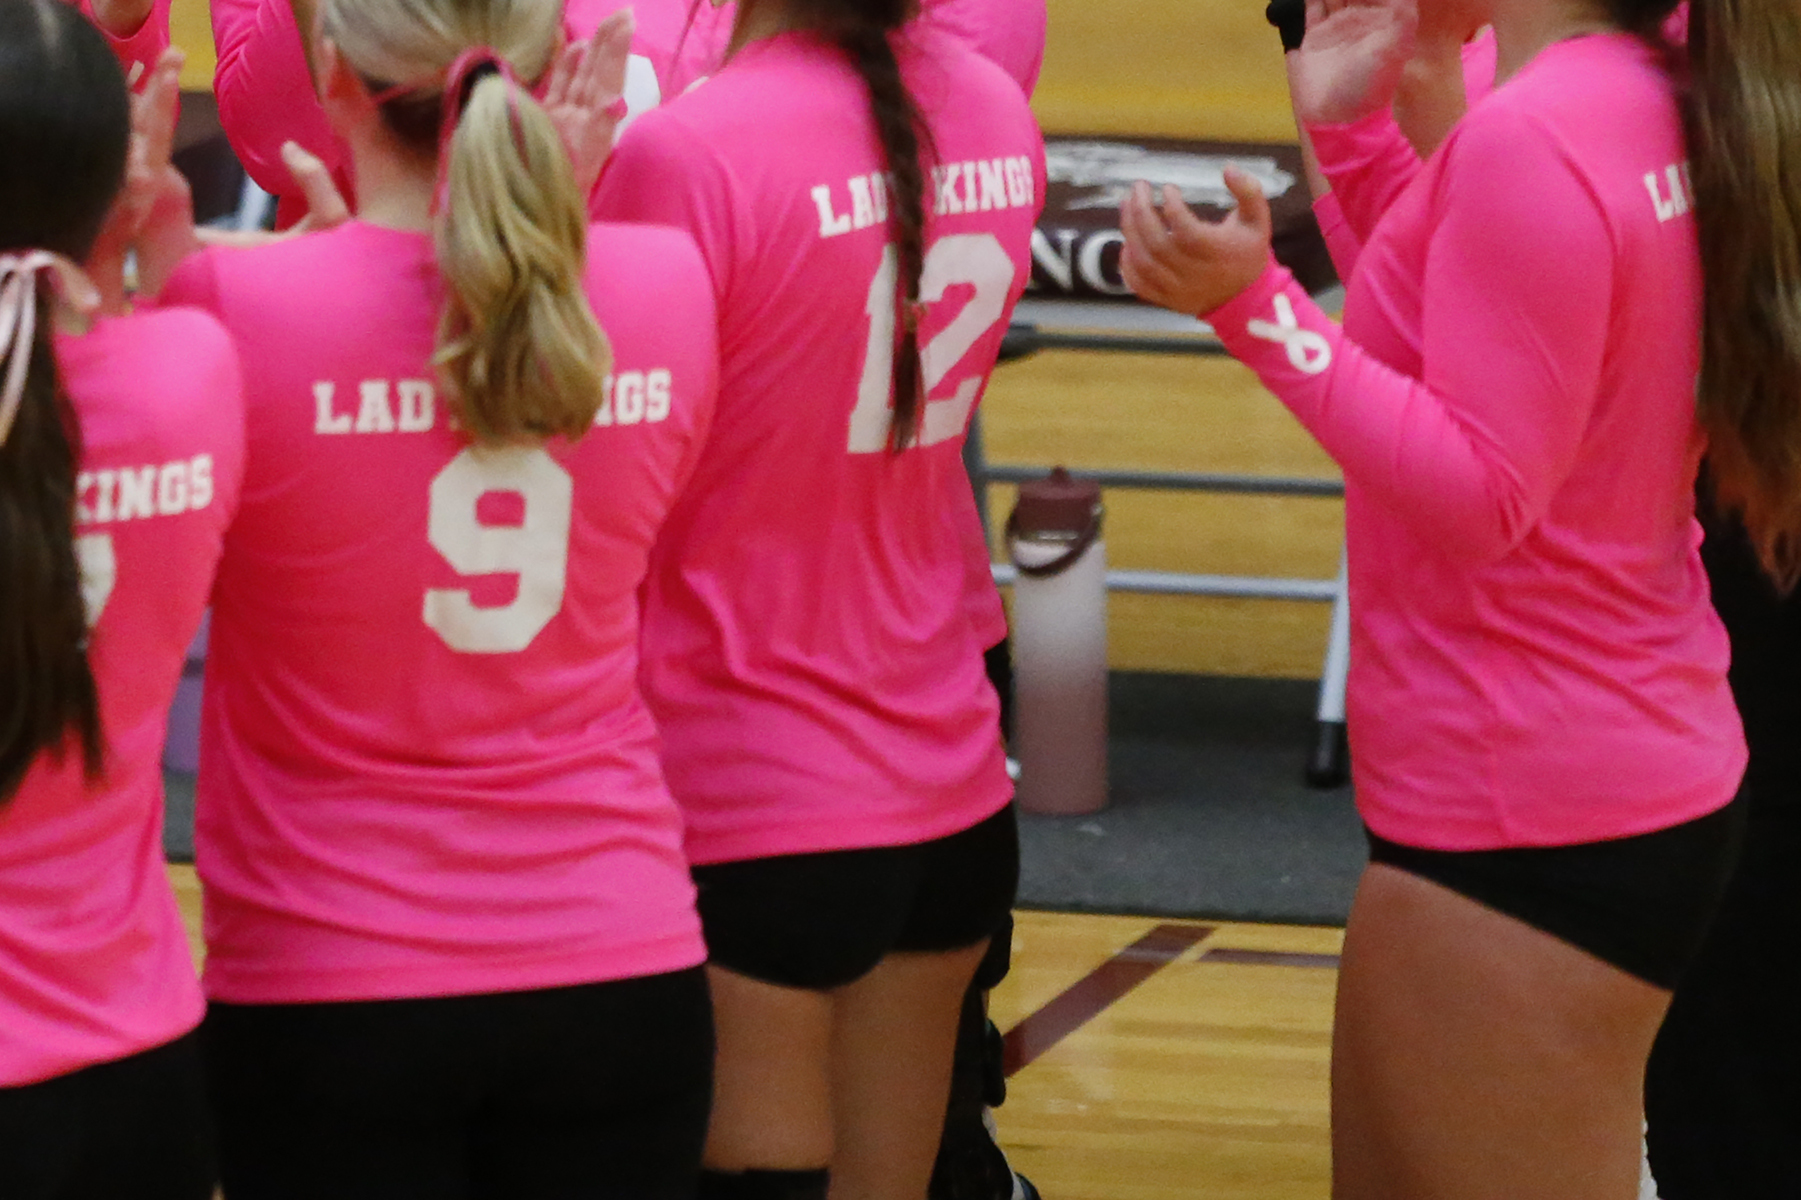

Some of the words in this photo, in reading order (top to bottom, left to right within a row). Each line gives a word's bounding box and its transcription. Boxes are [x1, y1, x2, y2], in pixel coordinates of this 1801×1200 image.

[312, 379, 437, 434] LAD
[848, 233, 1015, 453] 12
[422, 448, 574, 653] 9
